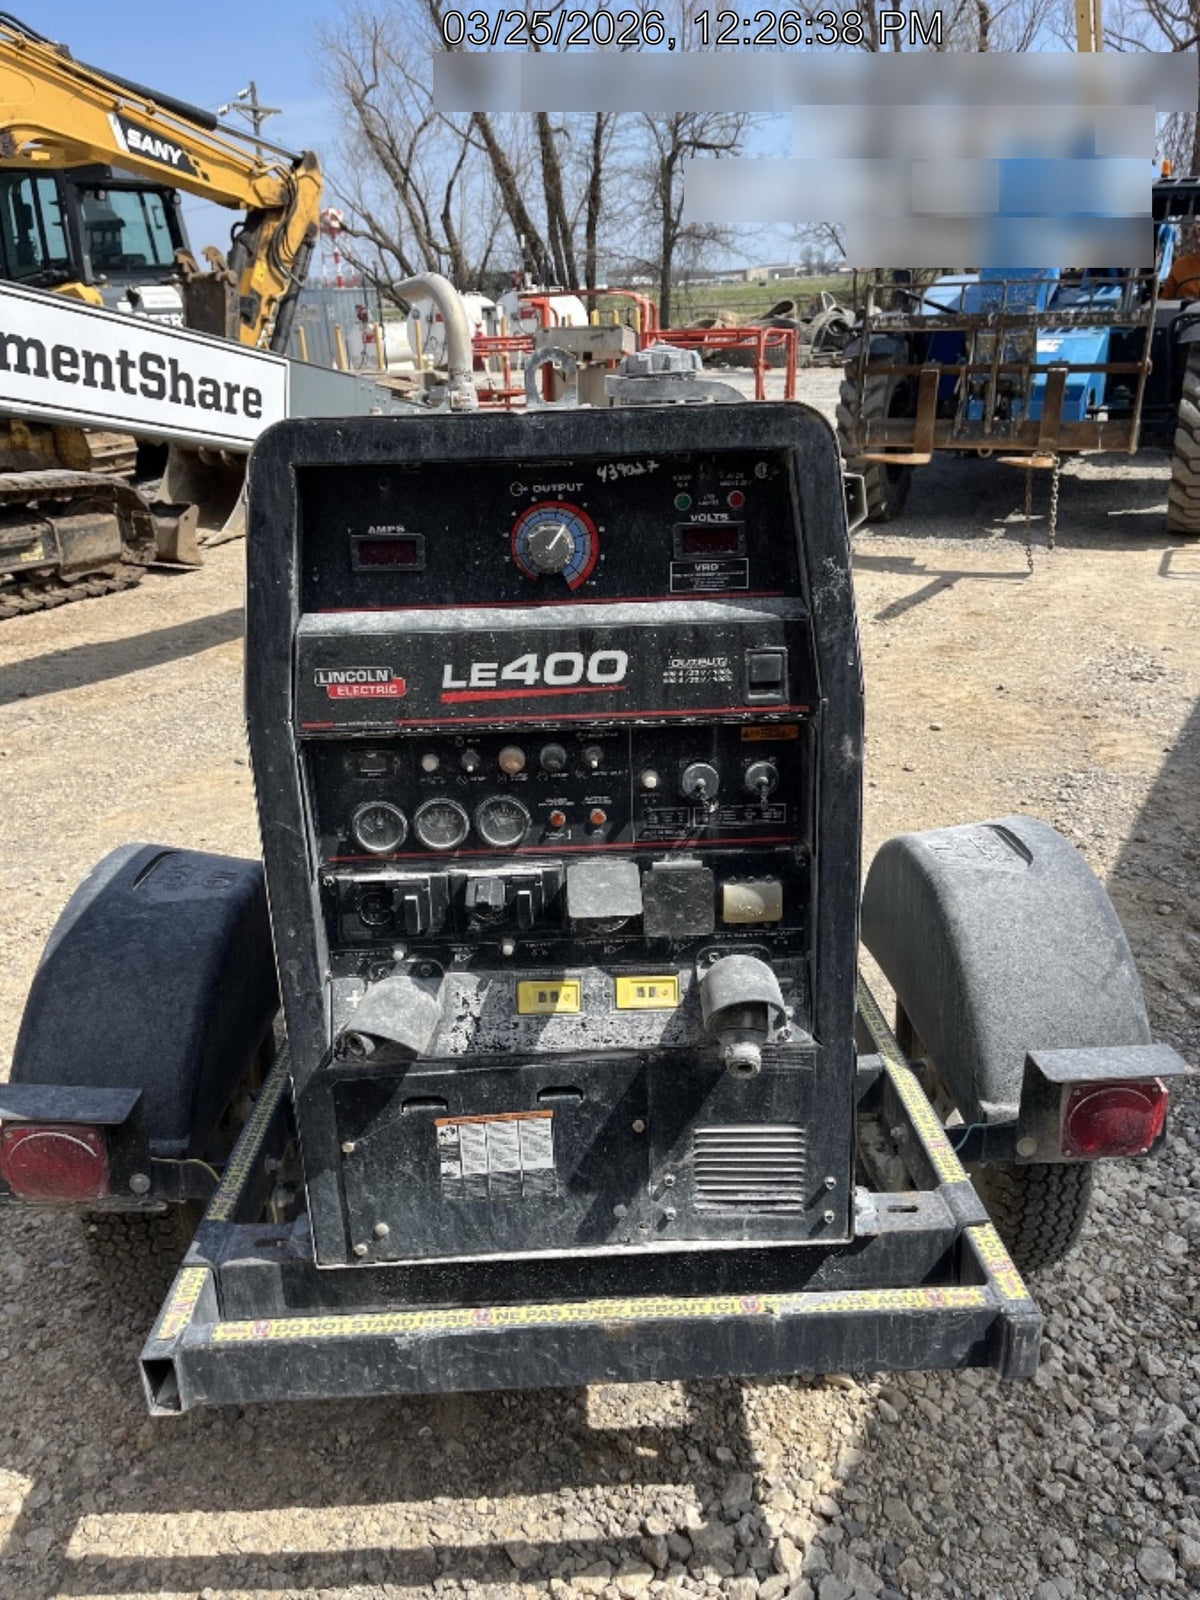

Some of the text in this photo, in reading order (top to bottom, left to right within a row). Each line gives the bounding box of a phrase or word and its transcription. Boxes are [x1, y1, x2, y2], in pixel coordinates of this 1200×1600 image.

[127, 127, 183, 165] SANY
[0, 330, 263, 420] mentShare
[532, 482, 584, 494] OUTPUT
[690, 512, 730, 523] VOLTS
[367, 524, 406, 535] AMPS
[318, 669, 389, 684] LINCOLN
[441, 649, 628, 689] LE400
[336, 684, 398, 696] ELECTRIC
[275, 1323, 310, 1333] DO
[314, 1321, 347, 1331] NOT
[351, 1318, 414, 1330] STAND
[418, 1315, 470, 1326] HERE
[495, 1311, 521, 1321] NE
[525, 1308, 561, 1319] PAS
[567, 1305, 625, 1316] TENEZ
[630, 1301, 706, 1313] DEBOUT
[710, 1301, 735, 1310] ICI
[877, 1294, 922, 1305] AQUI
